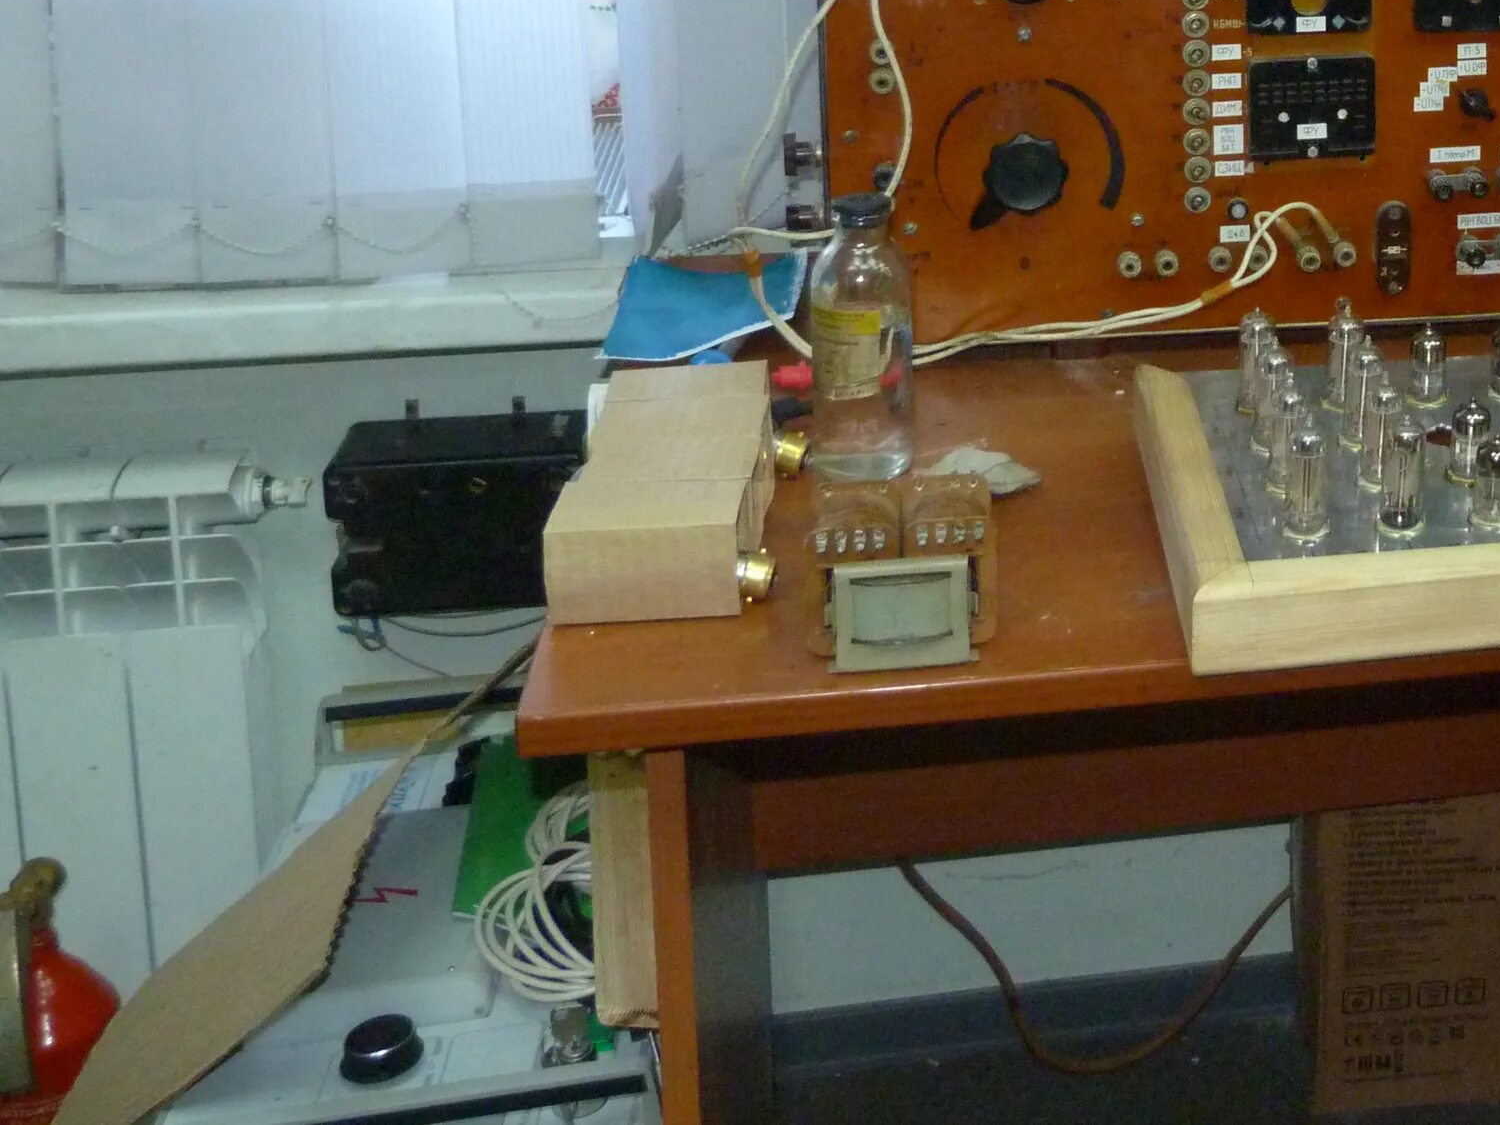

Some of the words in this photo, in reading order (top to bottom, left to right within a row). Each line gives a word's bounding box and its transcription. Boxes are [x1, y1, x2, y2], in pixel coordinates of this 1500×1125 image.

[1213, 18, 1246, 29] КБМШ-
[1217, 75, 1237, 86] РНП
[1215, 103, 1238, 115] ДИМ
[1303, 125, 1319, 136] ФУ
